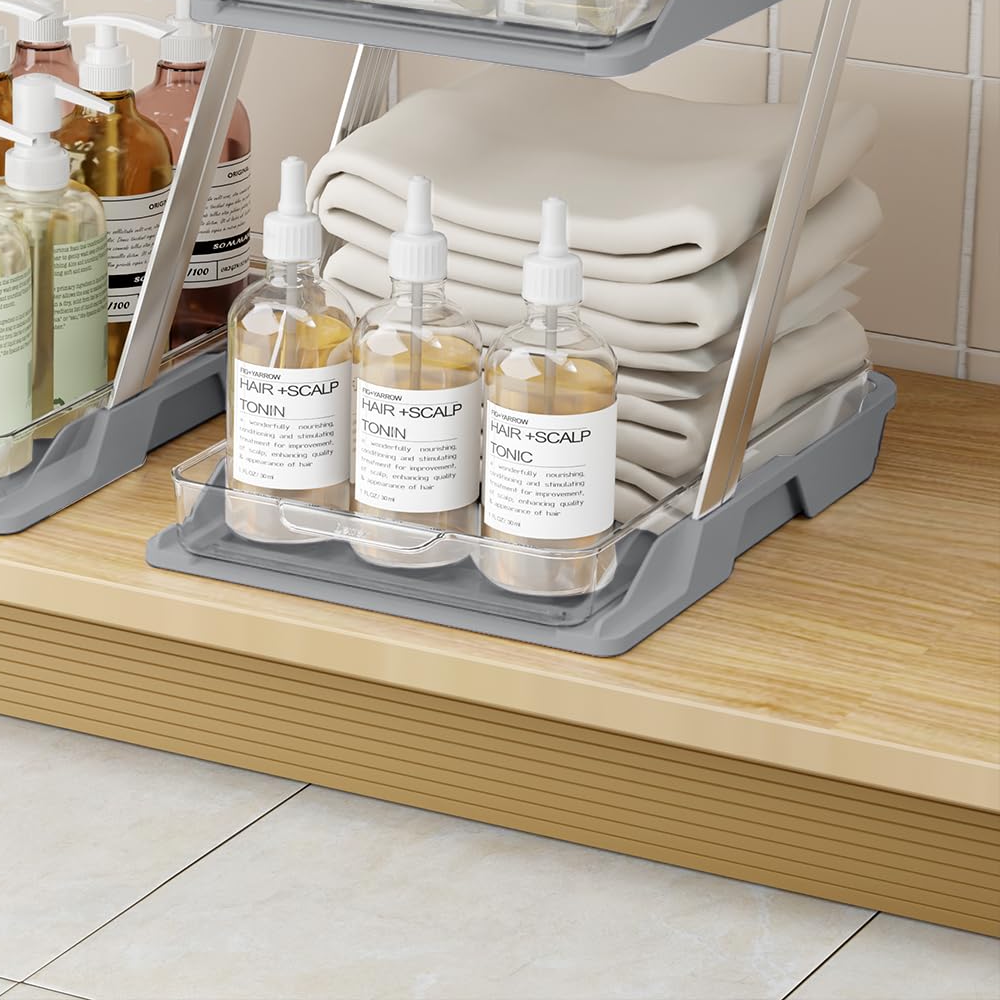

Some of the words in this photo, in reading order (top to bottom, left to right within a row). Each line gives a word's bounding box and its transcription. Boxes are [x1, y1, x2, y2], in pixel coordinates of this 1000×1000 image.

[240, 377, 274, 396] HAIR
[239, 398, 285, 418] TONIN
[362, 398, 395, 417] HAIR
[249, 420, 291, 431] wonderfully
[361, 418, 406, 440] TONIN
[490, 420, 522, 441] HAIR
[239, 426, 276, 439] conditioning
[297, 430, 335, 440] stimulating
[239, 435, 271, 447] treatment
[273, 441, 285, 449] for
[370, 442, 412, 453] wonderfully
[271, 451, 308, 459] enhancing
[311, 449, 334, 458] quality
[361, 447, 397, 461] conditioning
[418, 453, 457, 462] stimulating
[490, 440, 533, 464] TONIC
[245, 456, 285, 467] appearance
[360, 456, 392, 469] treatment
[394, 463, 407, 471] for
[392, 473, 430, 481] enhancing
[433, 472, 457, 481] quality
[498, 464, 538, 478] wonderfully
[367, 478, 406, 490] appearance
[489, 470, 523, 486] conditioning
[544, 480, 585, 488] stimulating
[489, 478, 518, 494] treatment
[520, 488, 532, 496] for
[494, 502, 531, 516] appearance
[518, 498, 556, 508] enhancing
[559, 499, 585, 508] quality
